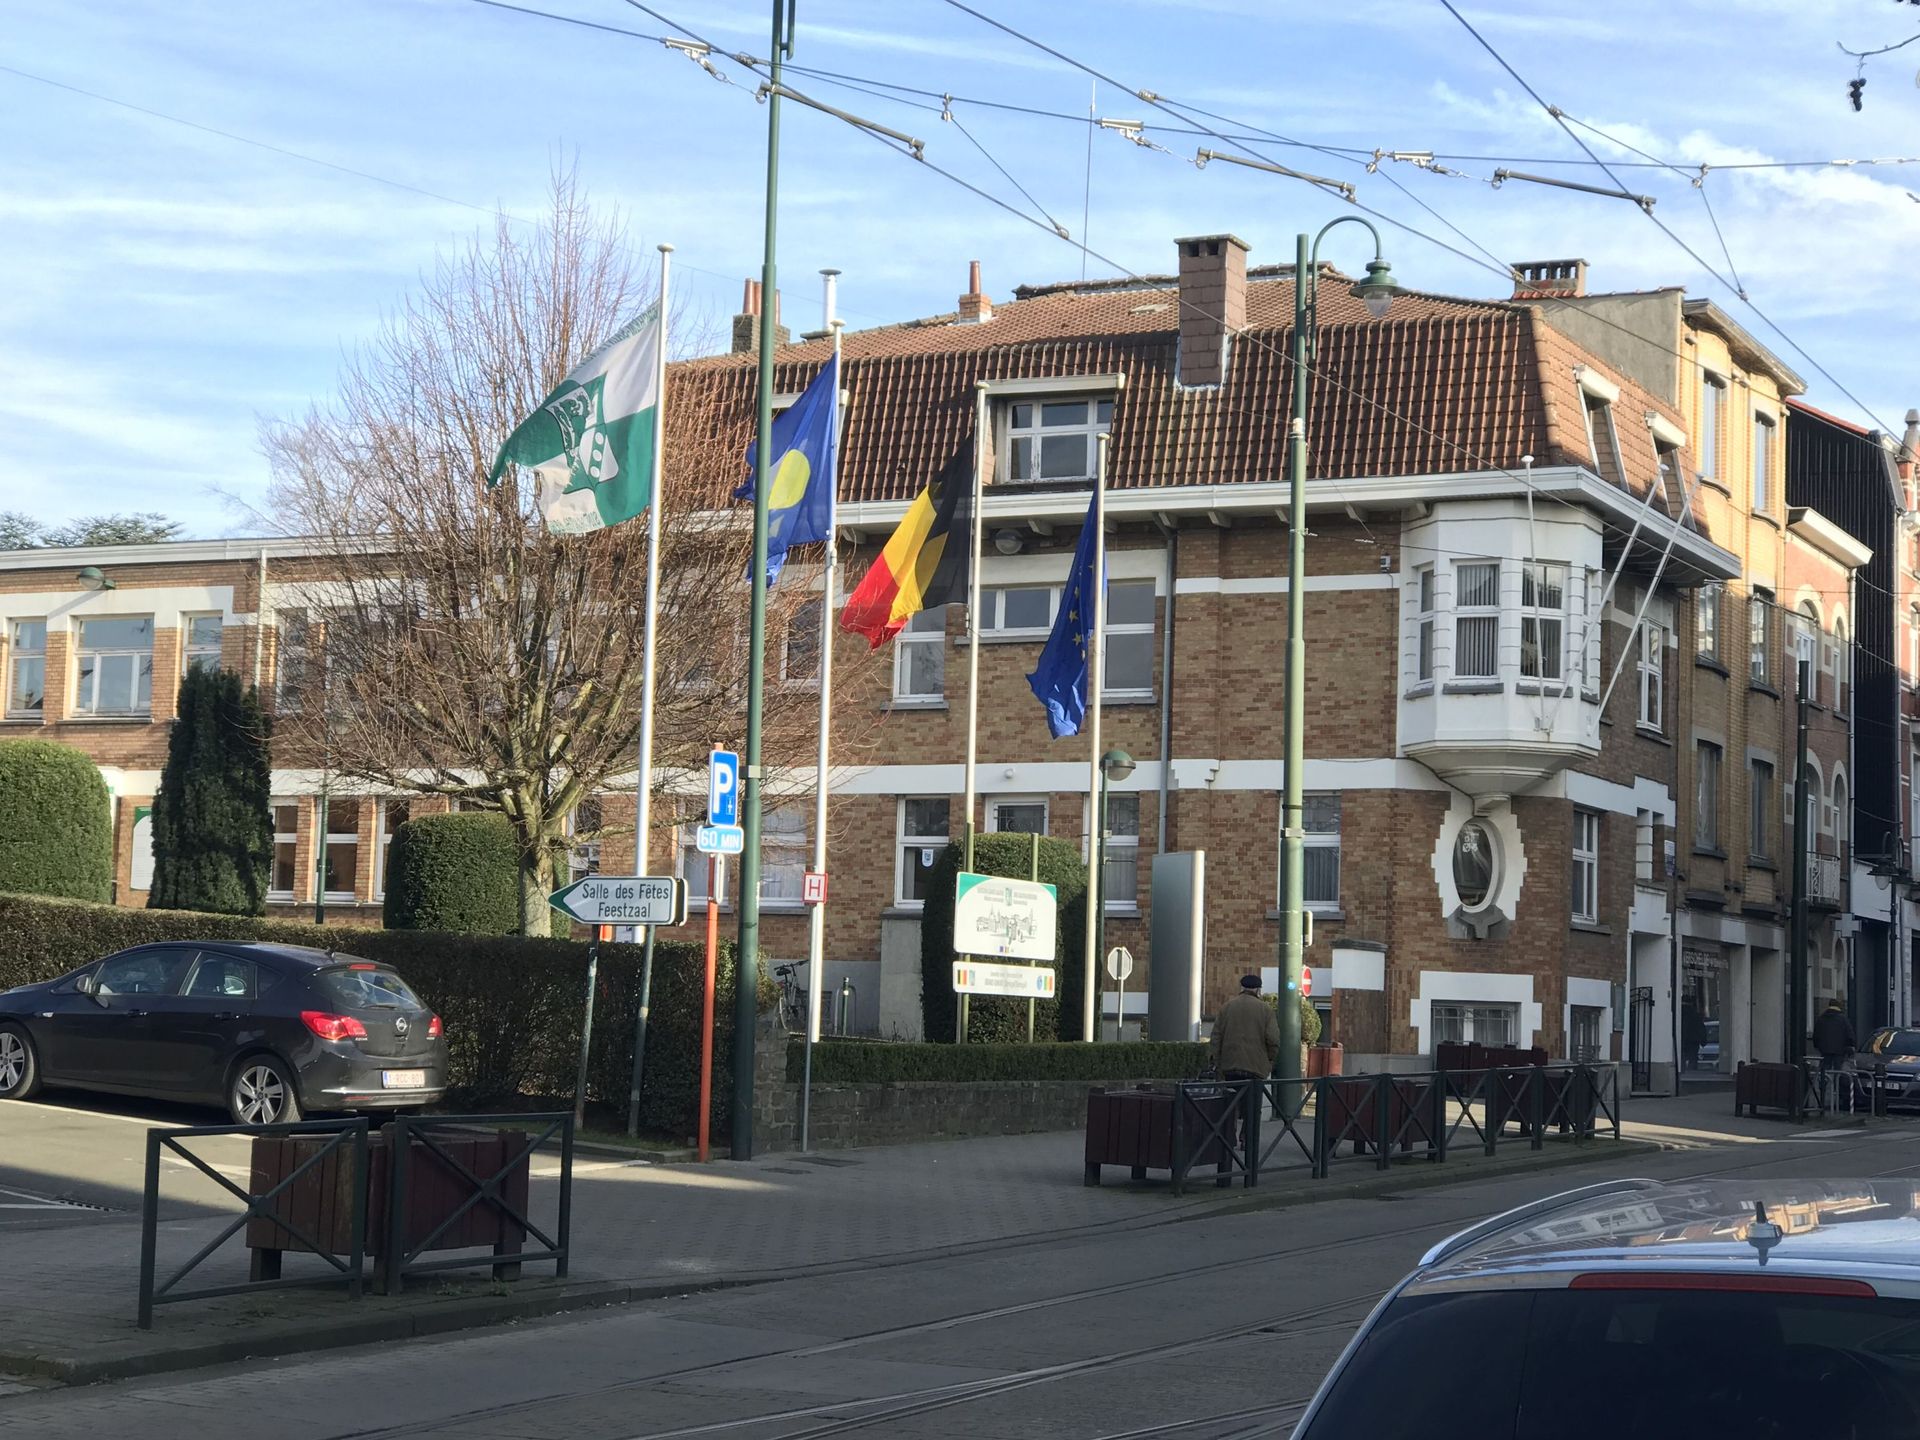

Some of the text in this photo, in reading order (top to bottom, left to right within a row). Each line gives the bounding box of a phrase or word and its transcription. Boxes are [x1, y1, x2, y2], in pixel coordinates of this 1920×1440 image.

[713, 762, 733, 813] P
[700, 830, 741, 849] 60 MIN
[582, 883, 669, 899] Salle des Fêtes
[808, 878, 821, 897] H
[598, 902, 651, 918] Feestzaal
